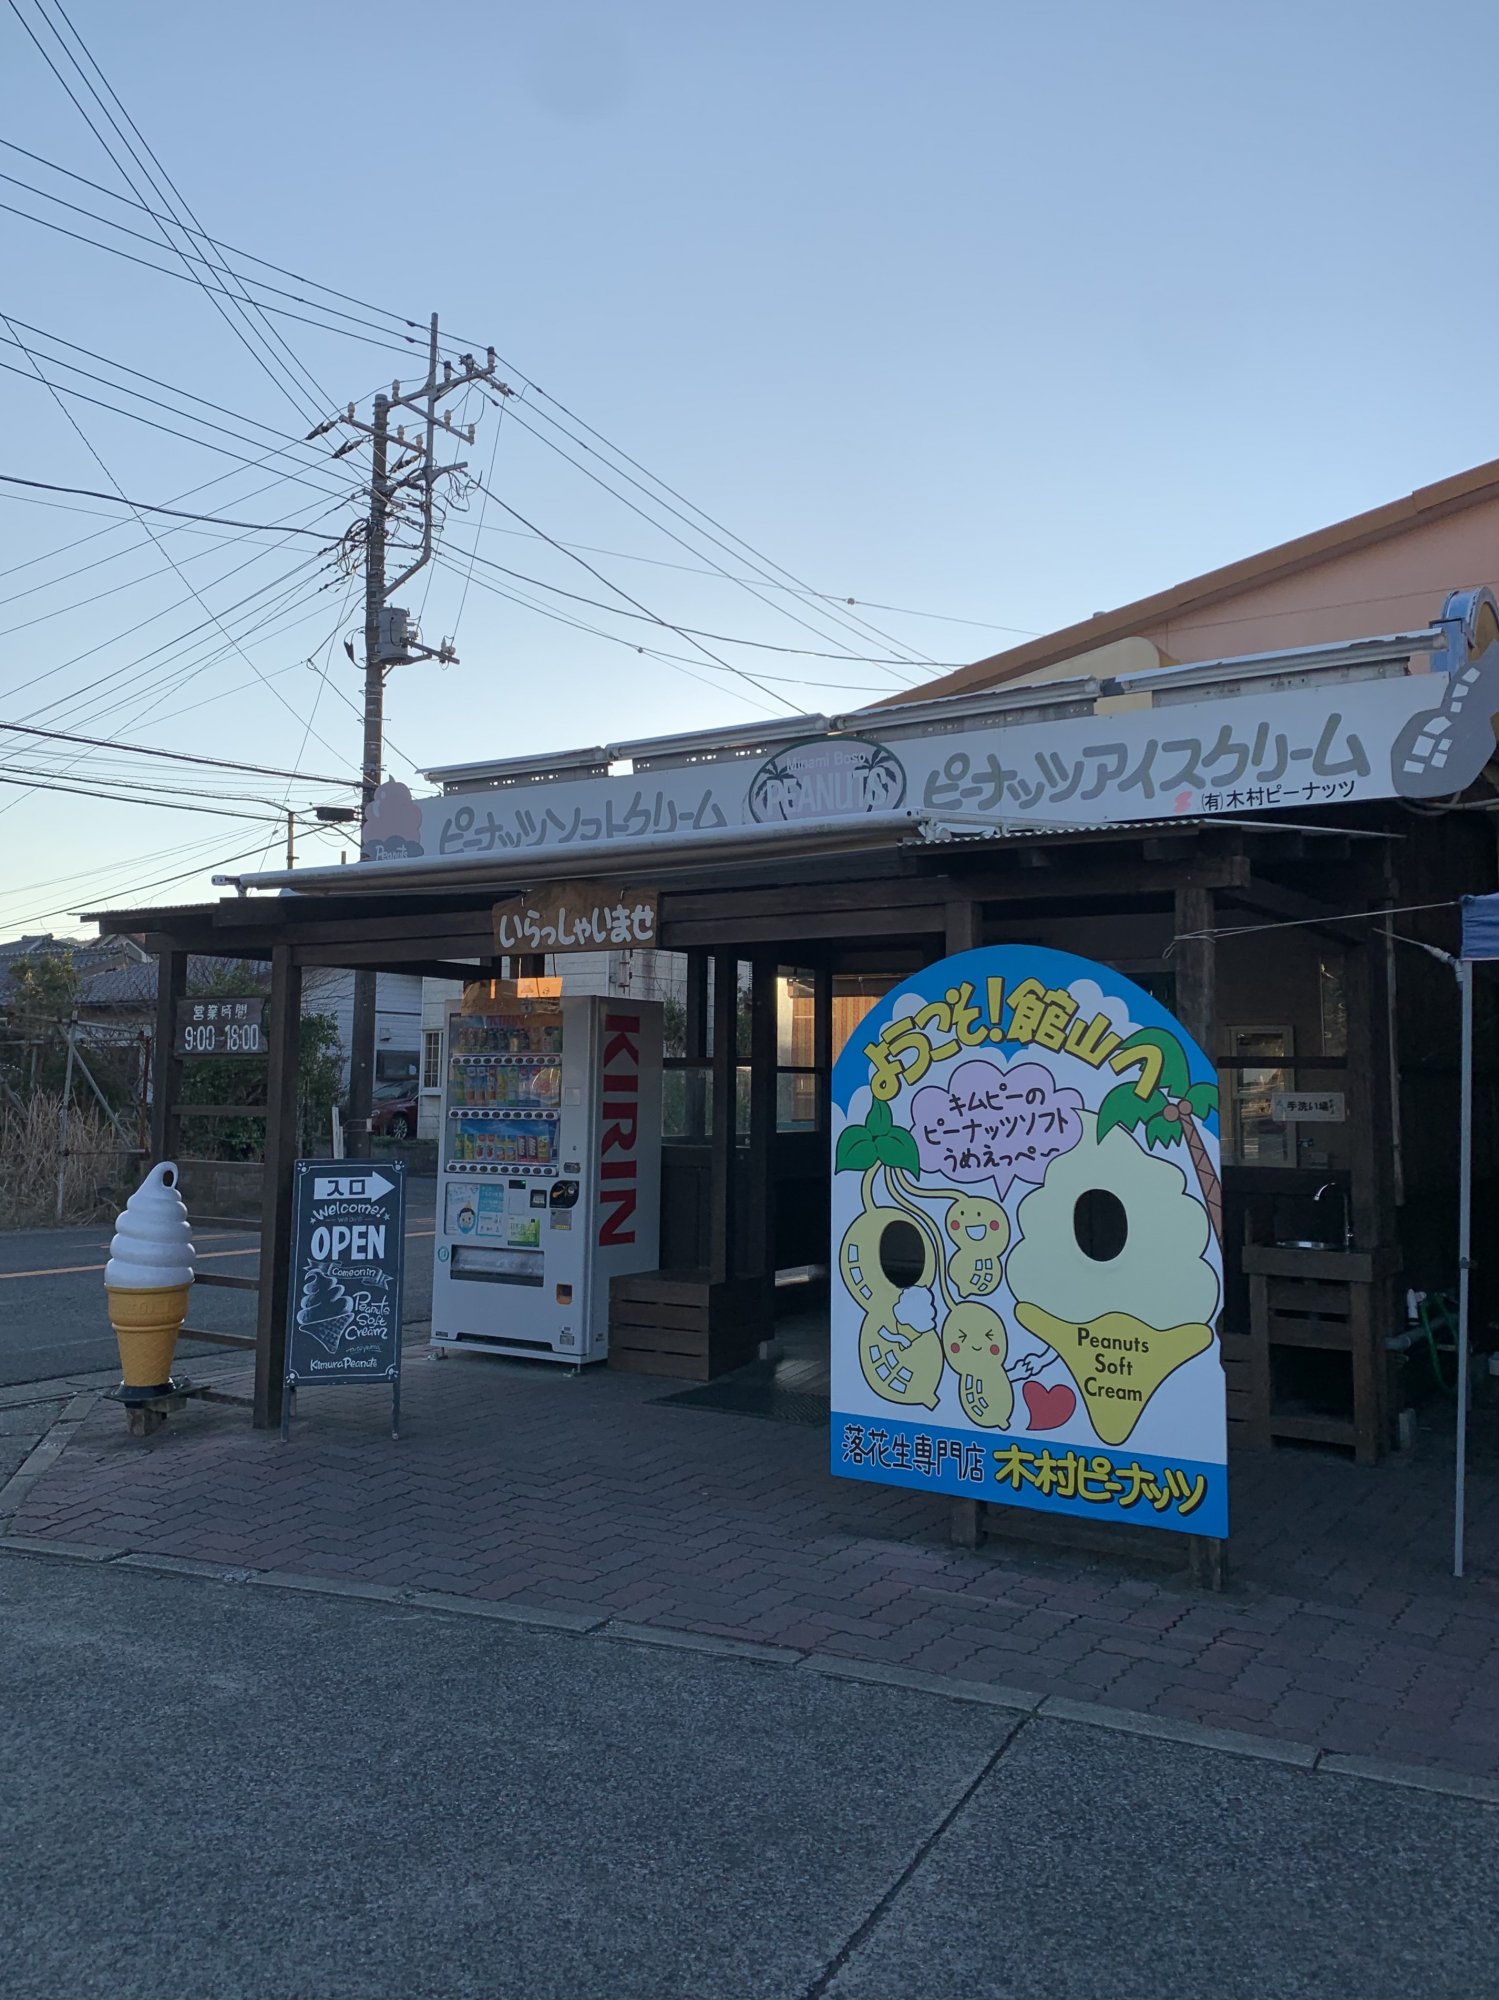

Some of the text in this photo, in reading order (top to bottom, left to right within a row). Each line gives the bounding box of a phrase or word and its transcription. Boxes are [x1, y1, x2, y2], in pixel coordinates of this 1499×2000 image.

[786, 752, 866, 771] Minami Boso
[923, 712, 1371, 812] ピーナッツアイスクリーム
[766, 767, 888, 816] PEANUTS
[375, 844, 409, 861] Peanuts
[499, 904, 655, 948] いらっしゃいませ
[193, 1003, 248, 1020] 営業時間
[948, 1082, 1046, 1117] キムピーの
[598, 1013, 641, 1248] KIRIN
[924, 1107, 1068, 1146] ピーナッツソフト
[327, 1179, 366, 1197] 入口
[312, 1201, 386, 1220] Welcome!
[310, 1224, 386, 1261] OPEN
[352, 1291, 391, 1316] Peanuts
[344, 1325, 389, 1340] Cream
[356, 1313, 388, 1329] Soft
[1077, 1327, 1150, 1354] Peanuts
[342, 1357, 377, 1369] Peanuts
[1094, 1354, 1133, 1377] Soft
[1083, 1377, 1143, 1402] Cream
[841, 1423, 986, 1483] 落花生専門店
[993, 1443, 1208, 1517] 木村ピーナッツ
